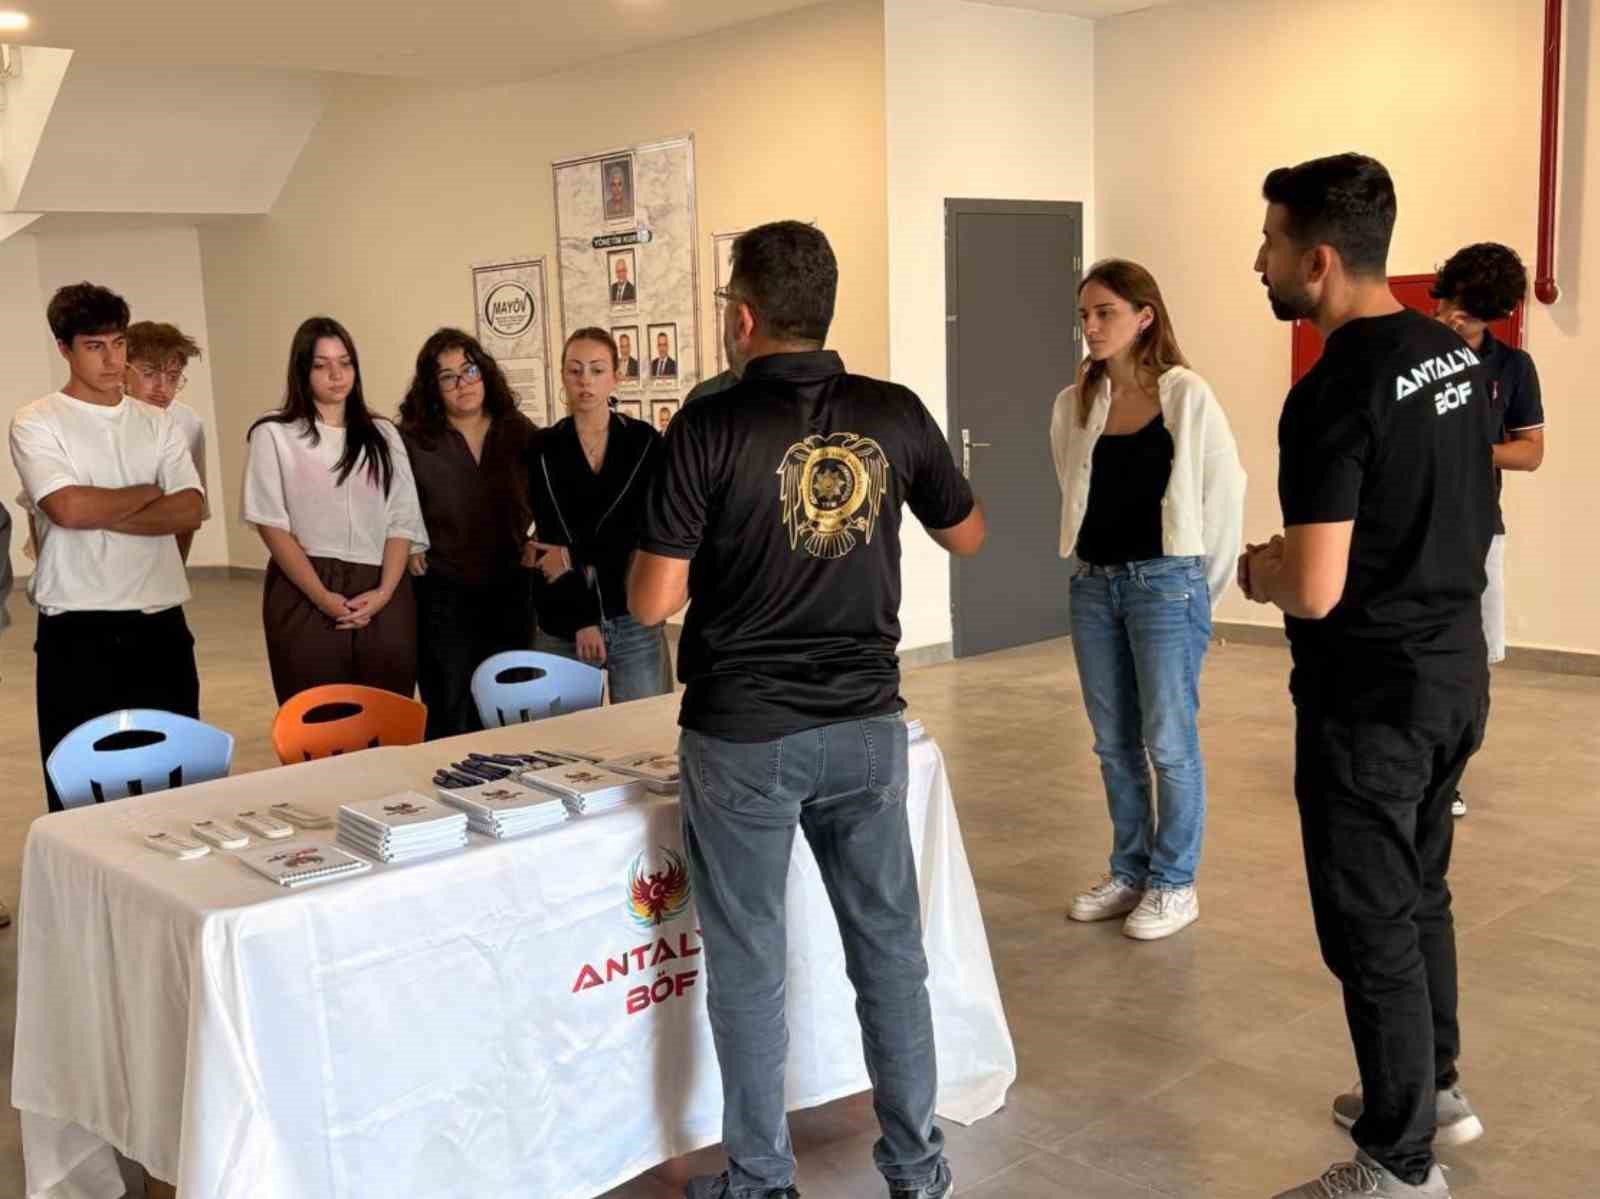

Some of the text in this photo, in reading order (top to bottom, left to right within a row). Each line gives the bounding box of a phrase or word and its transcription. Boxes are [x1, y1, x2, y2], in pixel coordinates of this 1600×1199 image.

[1434, 381, 1472, 415] BÖF
[572, 928, 704, 993] ANTAL
[626, 970, 698, 1014] BÖF
